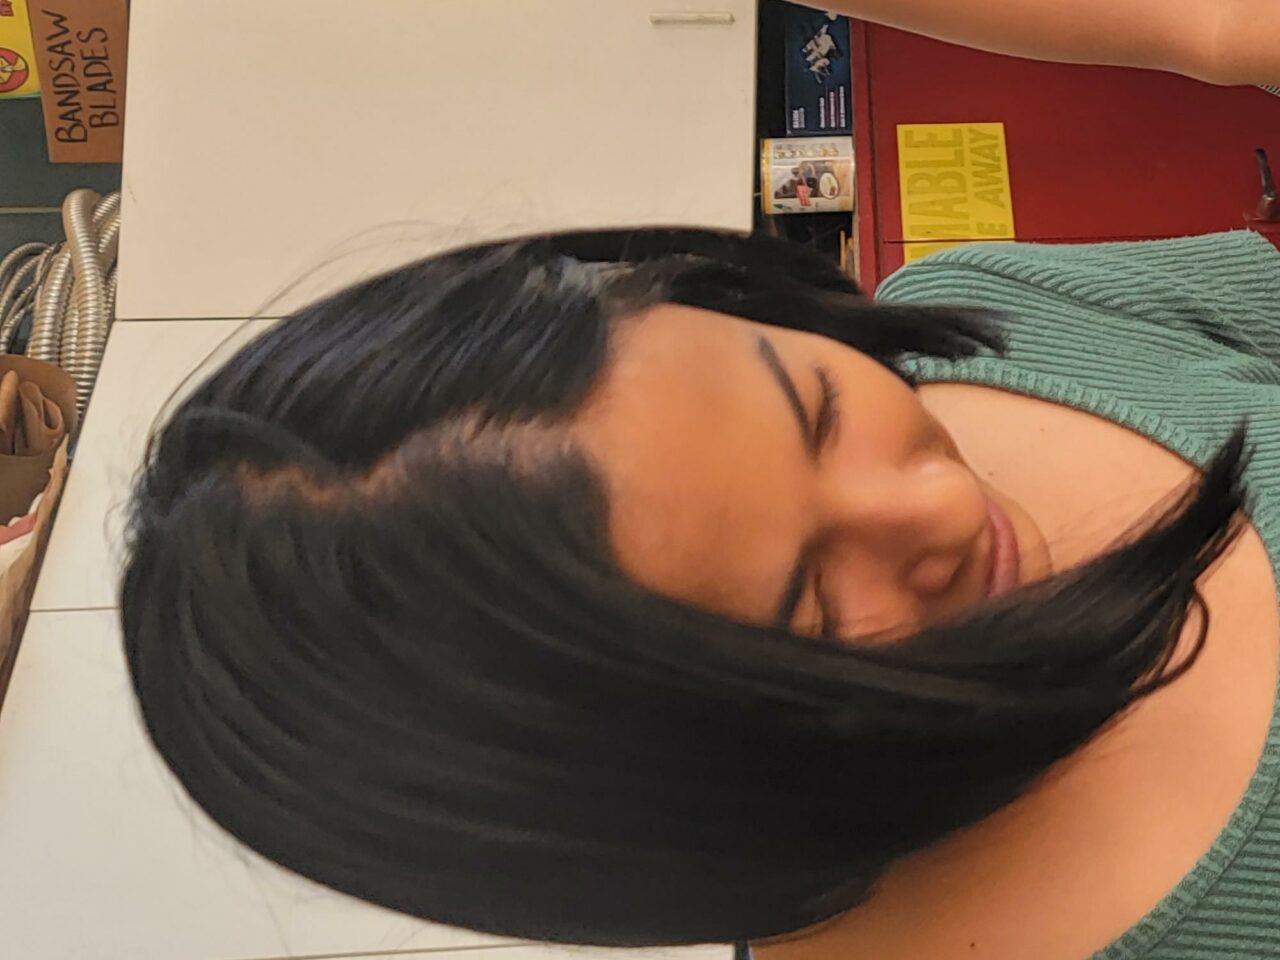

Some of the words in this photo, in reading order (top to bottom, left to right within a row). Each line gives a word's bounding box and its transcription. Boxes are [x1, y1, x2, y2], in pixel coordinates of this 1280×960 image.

[41, 9, 88, 143] BANDSAW
[76, 27, 119, 128] BLADES
[970, 128, 1003, 208] AWAY
